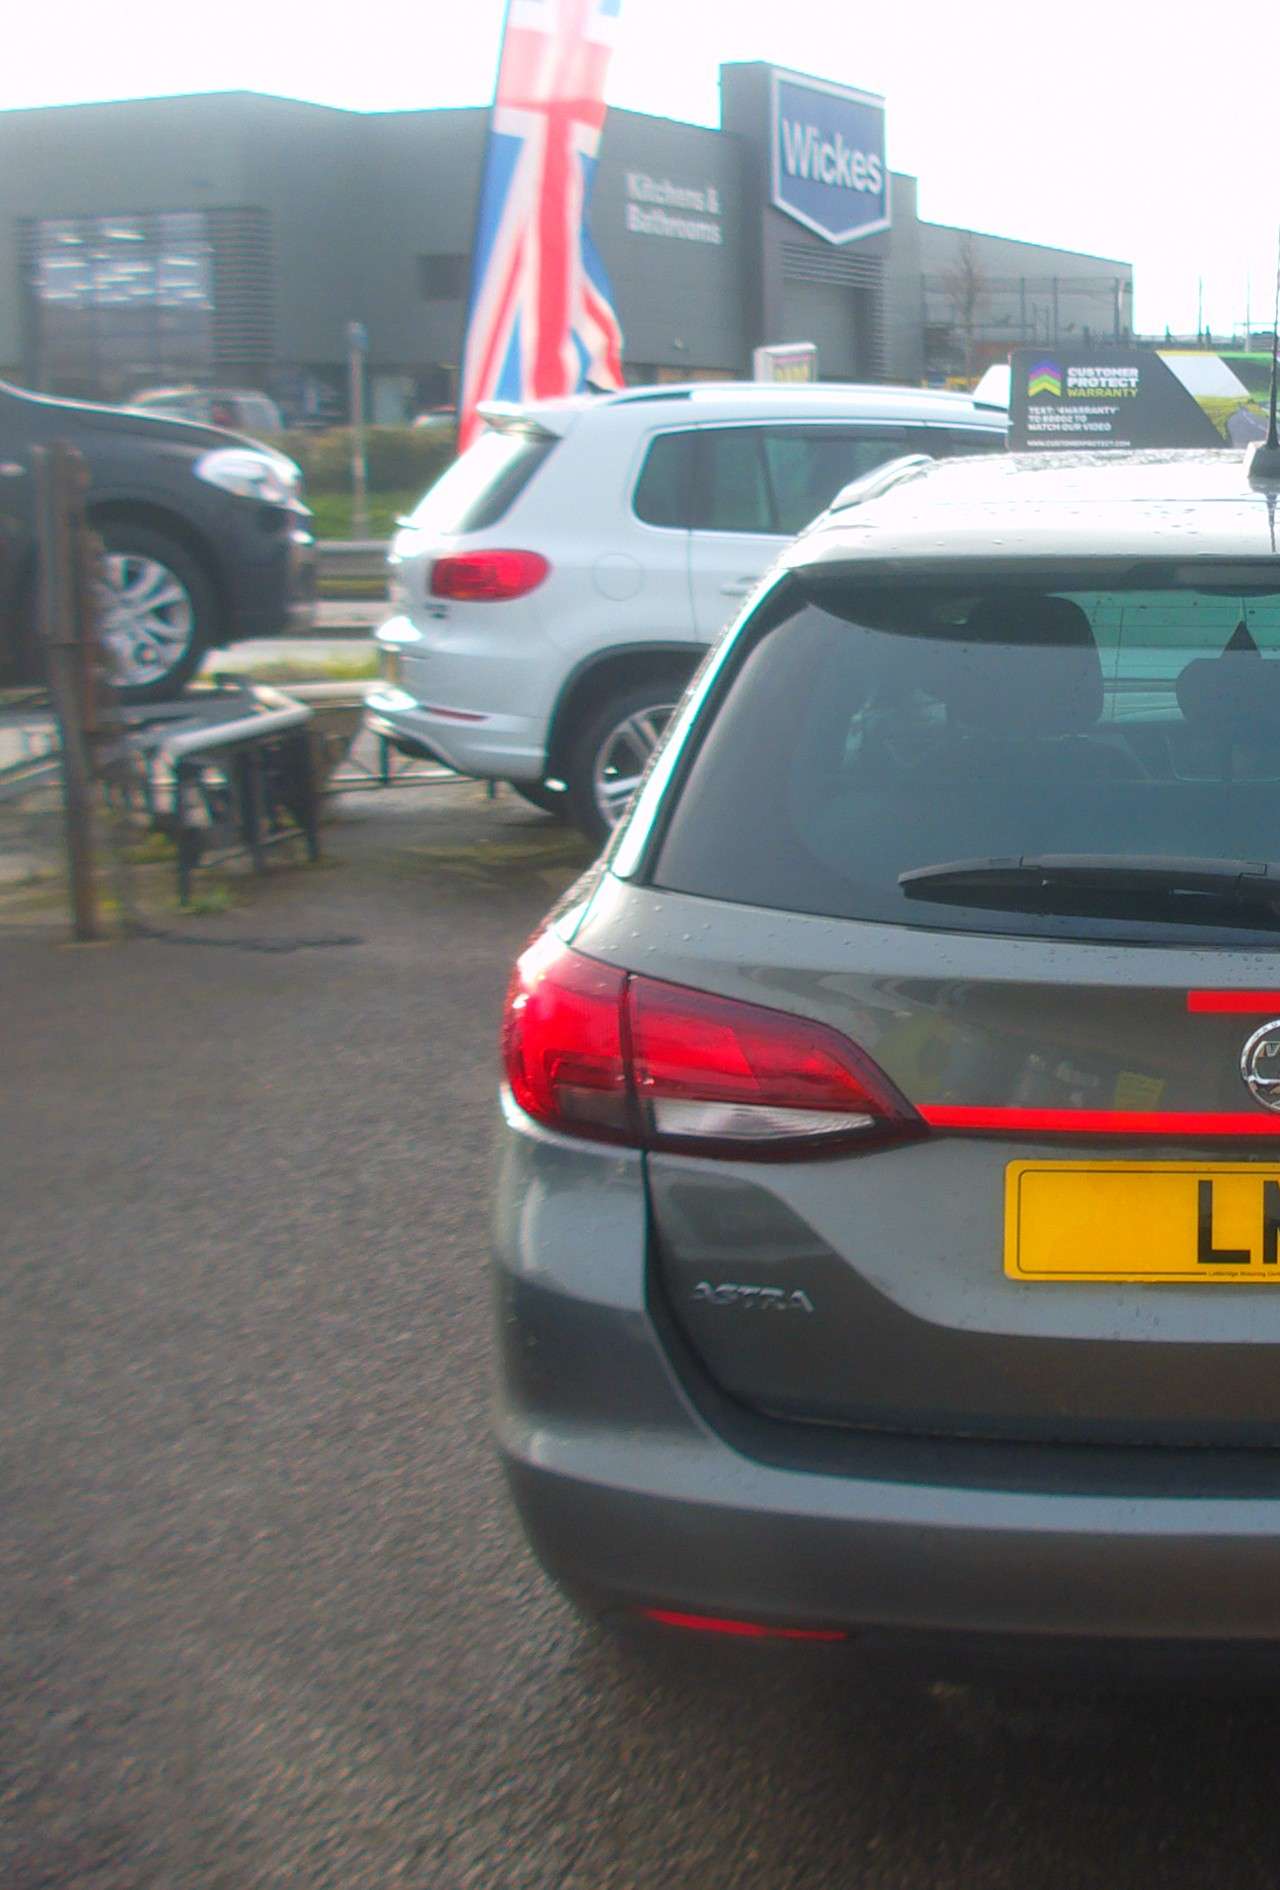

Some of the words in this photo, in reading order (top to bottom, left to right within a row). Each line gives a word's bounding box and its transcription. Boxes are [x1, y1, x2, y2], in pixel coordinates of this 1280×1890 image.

[783, 118, 882, 194] Wickes
[627, 173, 704, 212] Kitchens
[706, 184, 720, 214] &
[626, 203, 721, 244] Bathrooms
[1067, 367, 1138, 377] CUSTOMER
[1067, 377, 1138, 387] PROTECT
[1067, 388, 1138, 398] WARRANTY
[1083, 422, 1112, 431] VIDEO
[691, 1281, 815, 1313] ASTRA
